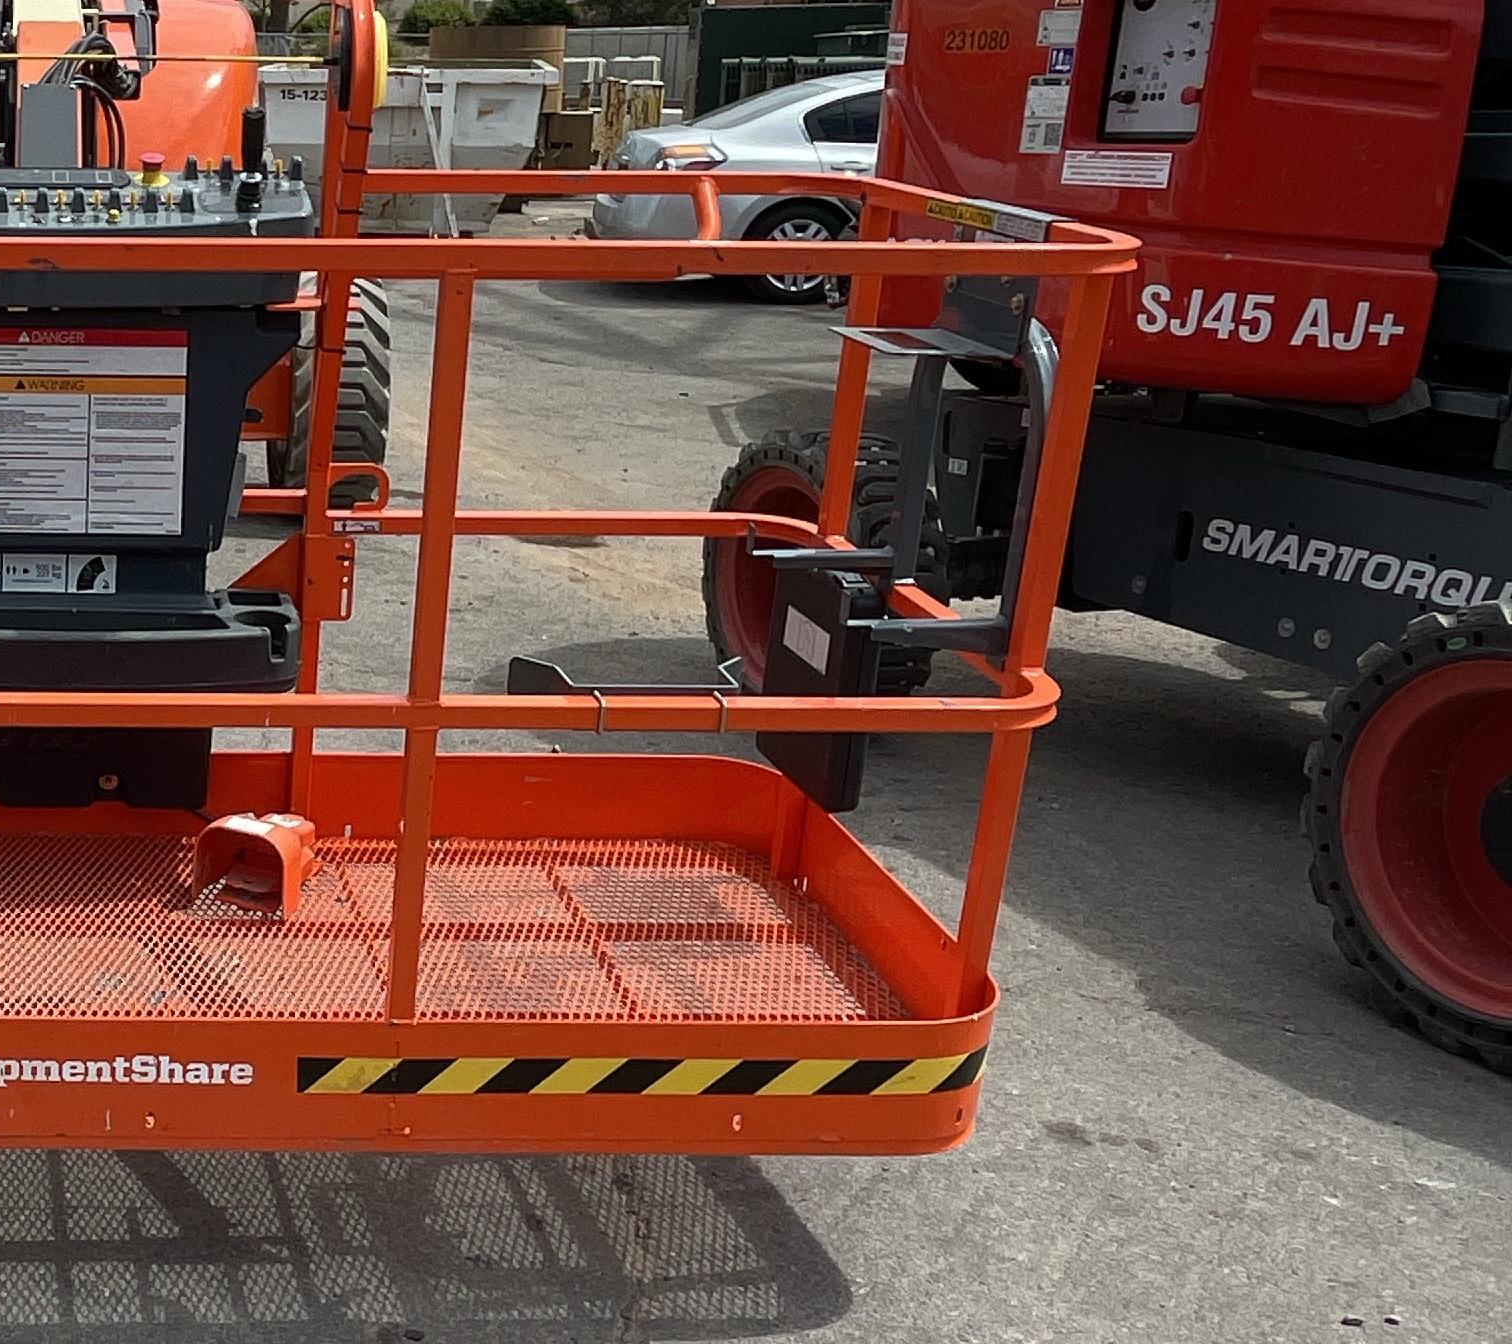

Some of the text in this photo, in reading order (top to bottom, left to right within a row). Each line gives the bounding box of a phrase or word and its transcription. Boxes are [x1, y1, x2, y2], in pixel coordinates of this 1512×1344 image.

[945, 29, 1011, 52] 231080
[1136, 283, 1405, 351] SJ45 AJ+
[31, 331, 85, 344] DANGER
[27, 378, 86, 392] WARNING
